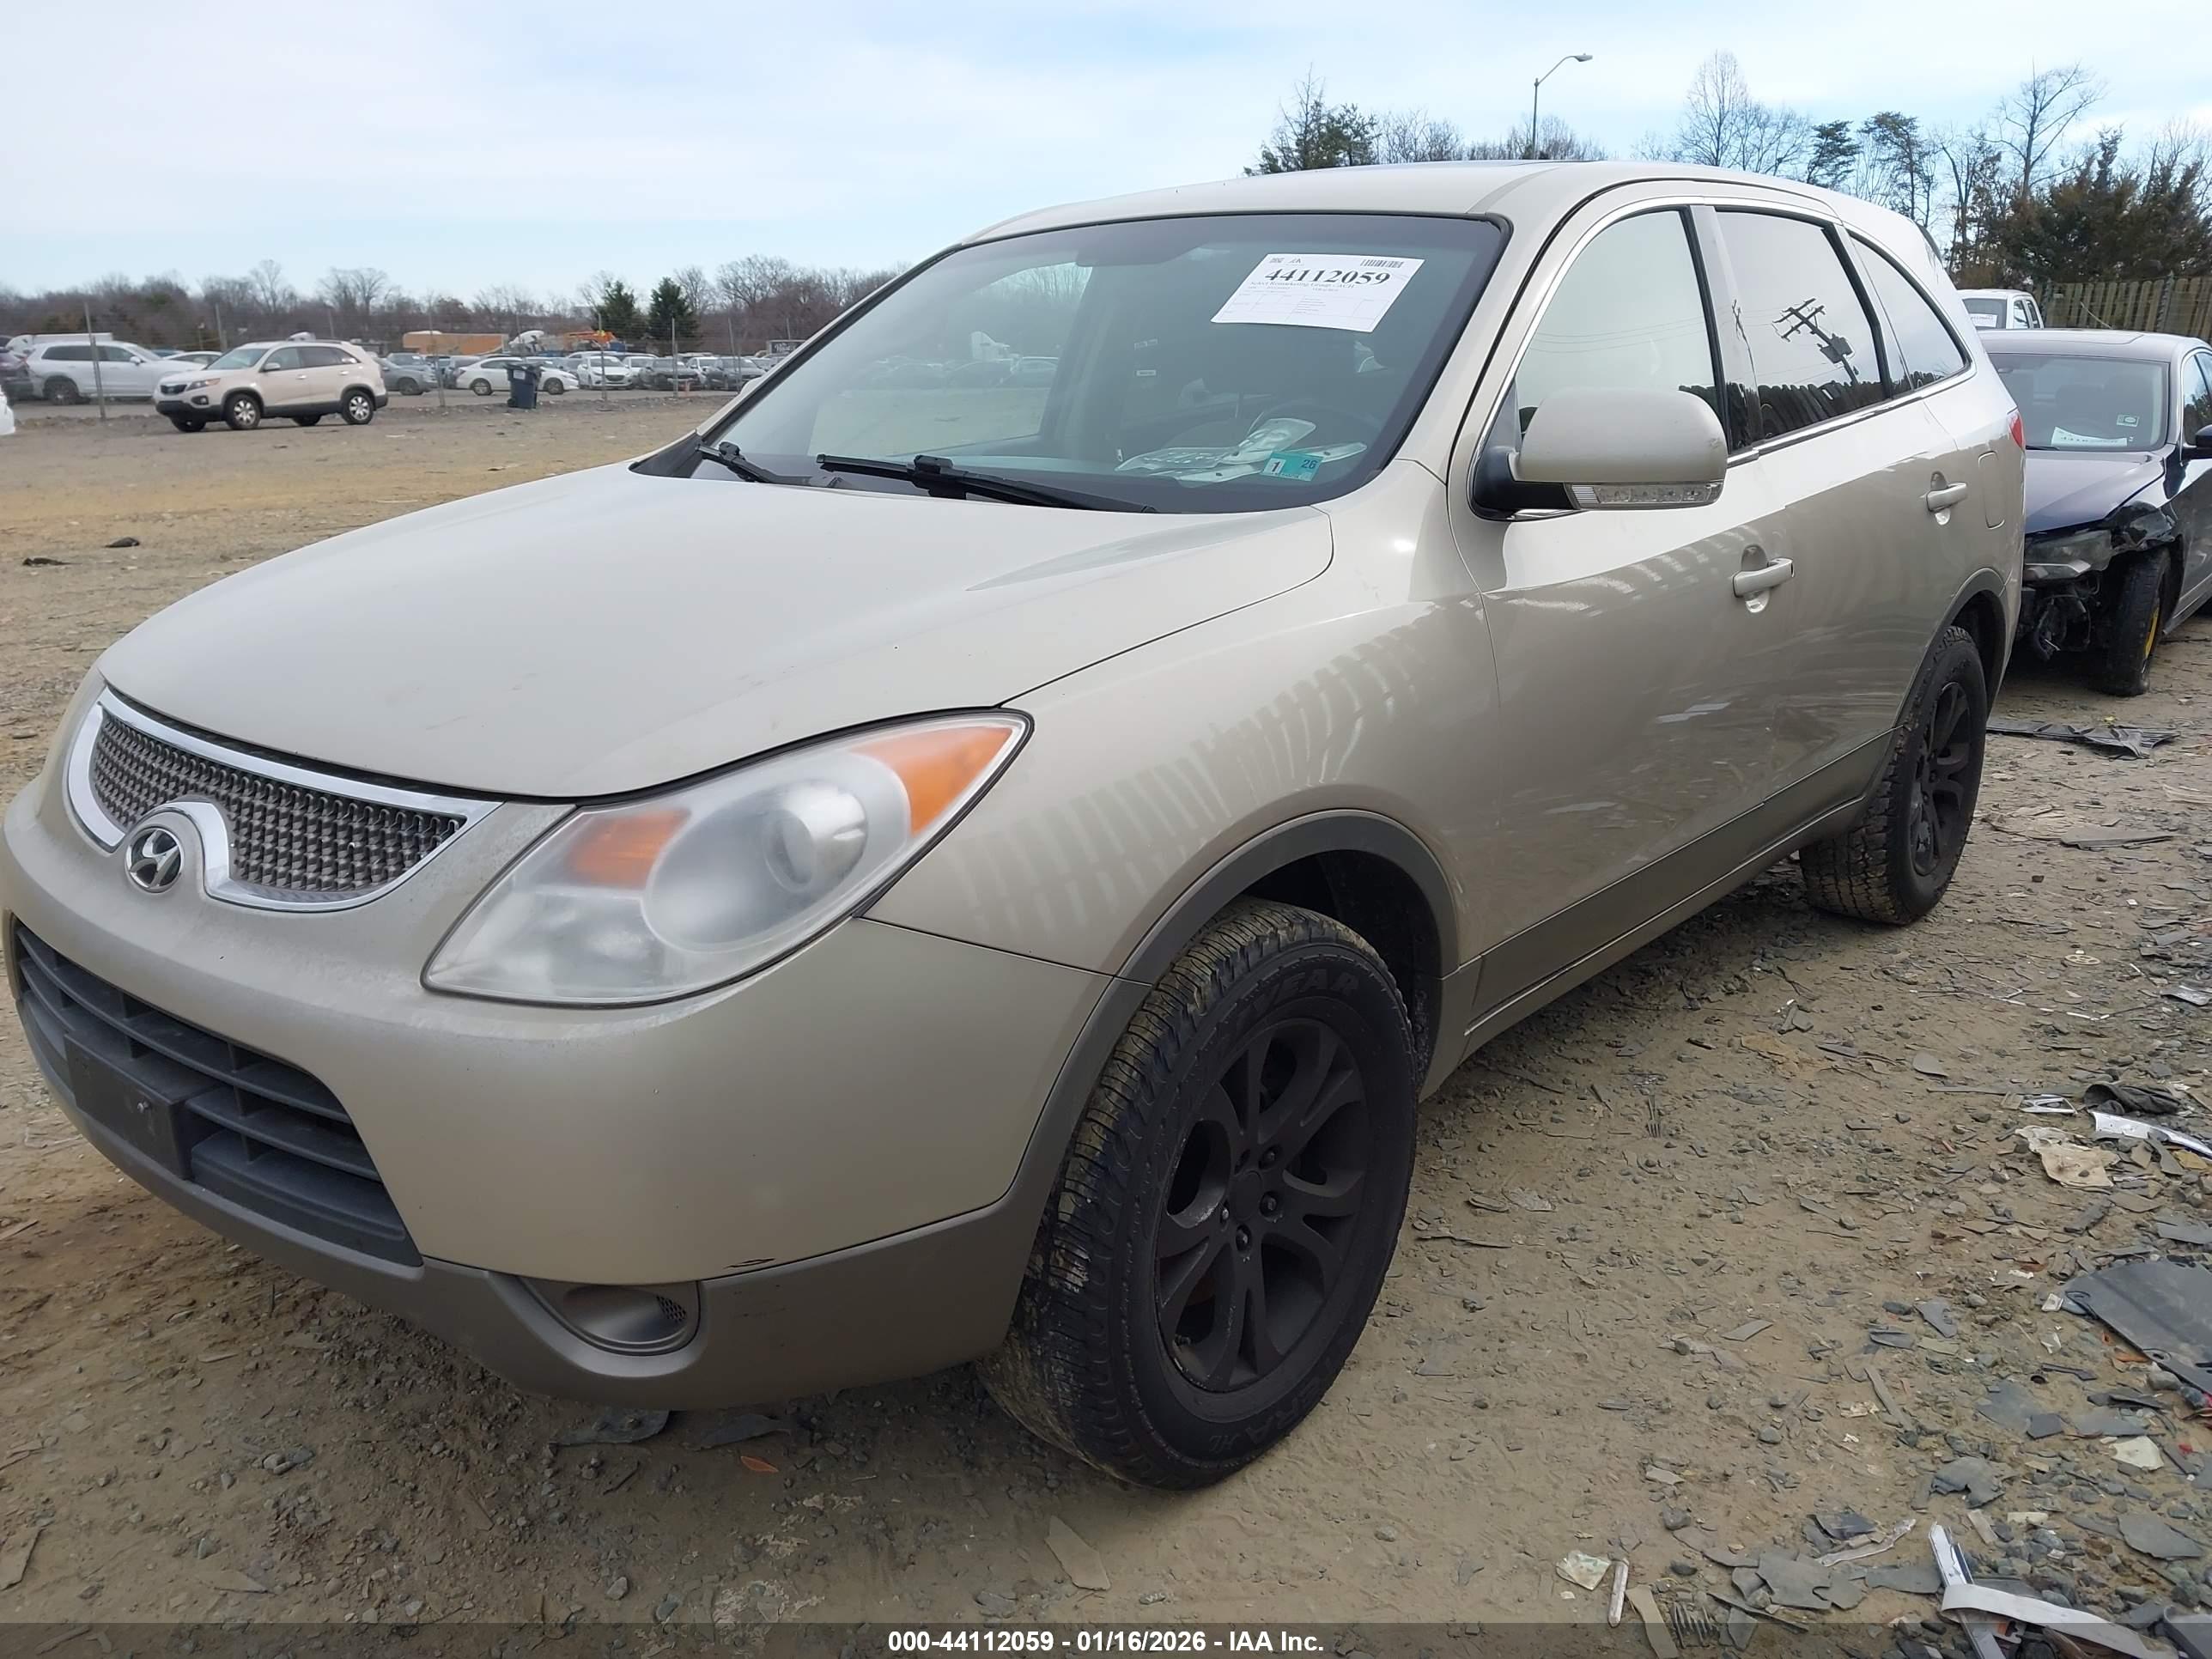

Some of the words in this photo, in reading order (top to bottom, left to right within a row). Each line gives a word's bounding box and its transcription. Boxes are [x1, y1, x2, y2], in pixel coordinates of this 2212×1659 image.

[1265, 269, 1390, 285] 44112059
[1272, 461, 1281, 472] 1
[1301, 459, 1318, 470] 26
